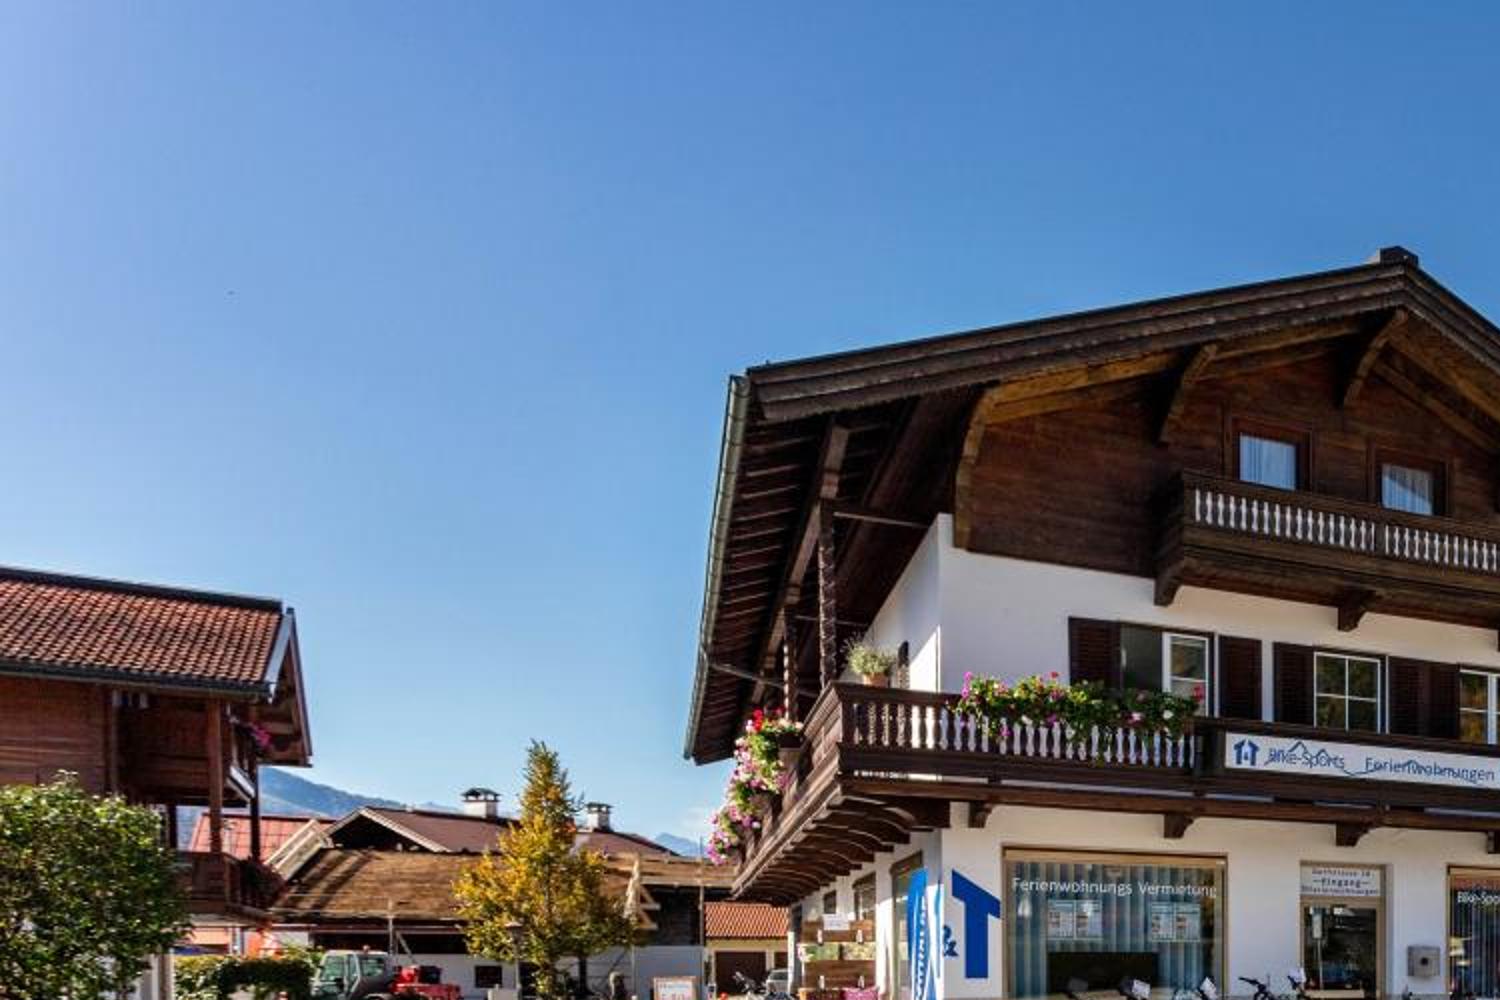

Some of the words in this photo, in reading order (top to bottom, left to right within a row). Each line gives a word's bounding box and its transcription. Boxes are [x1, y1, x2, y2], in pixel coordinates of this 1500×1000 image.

[1365, 757, 1495, 783] Ferienwohnungen
[1012, 876, 1133, 896] Ferienwohnungs
[1137, 879, 1217, 898] Vermietung
